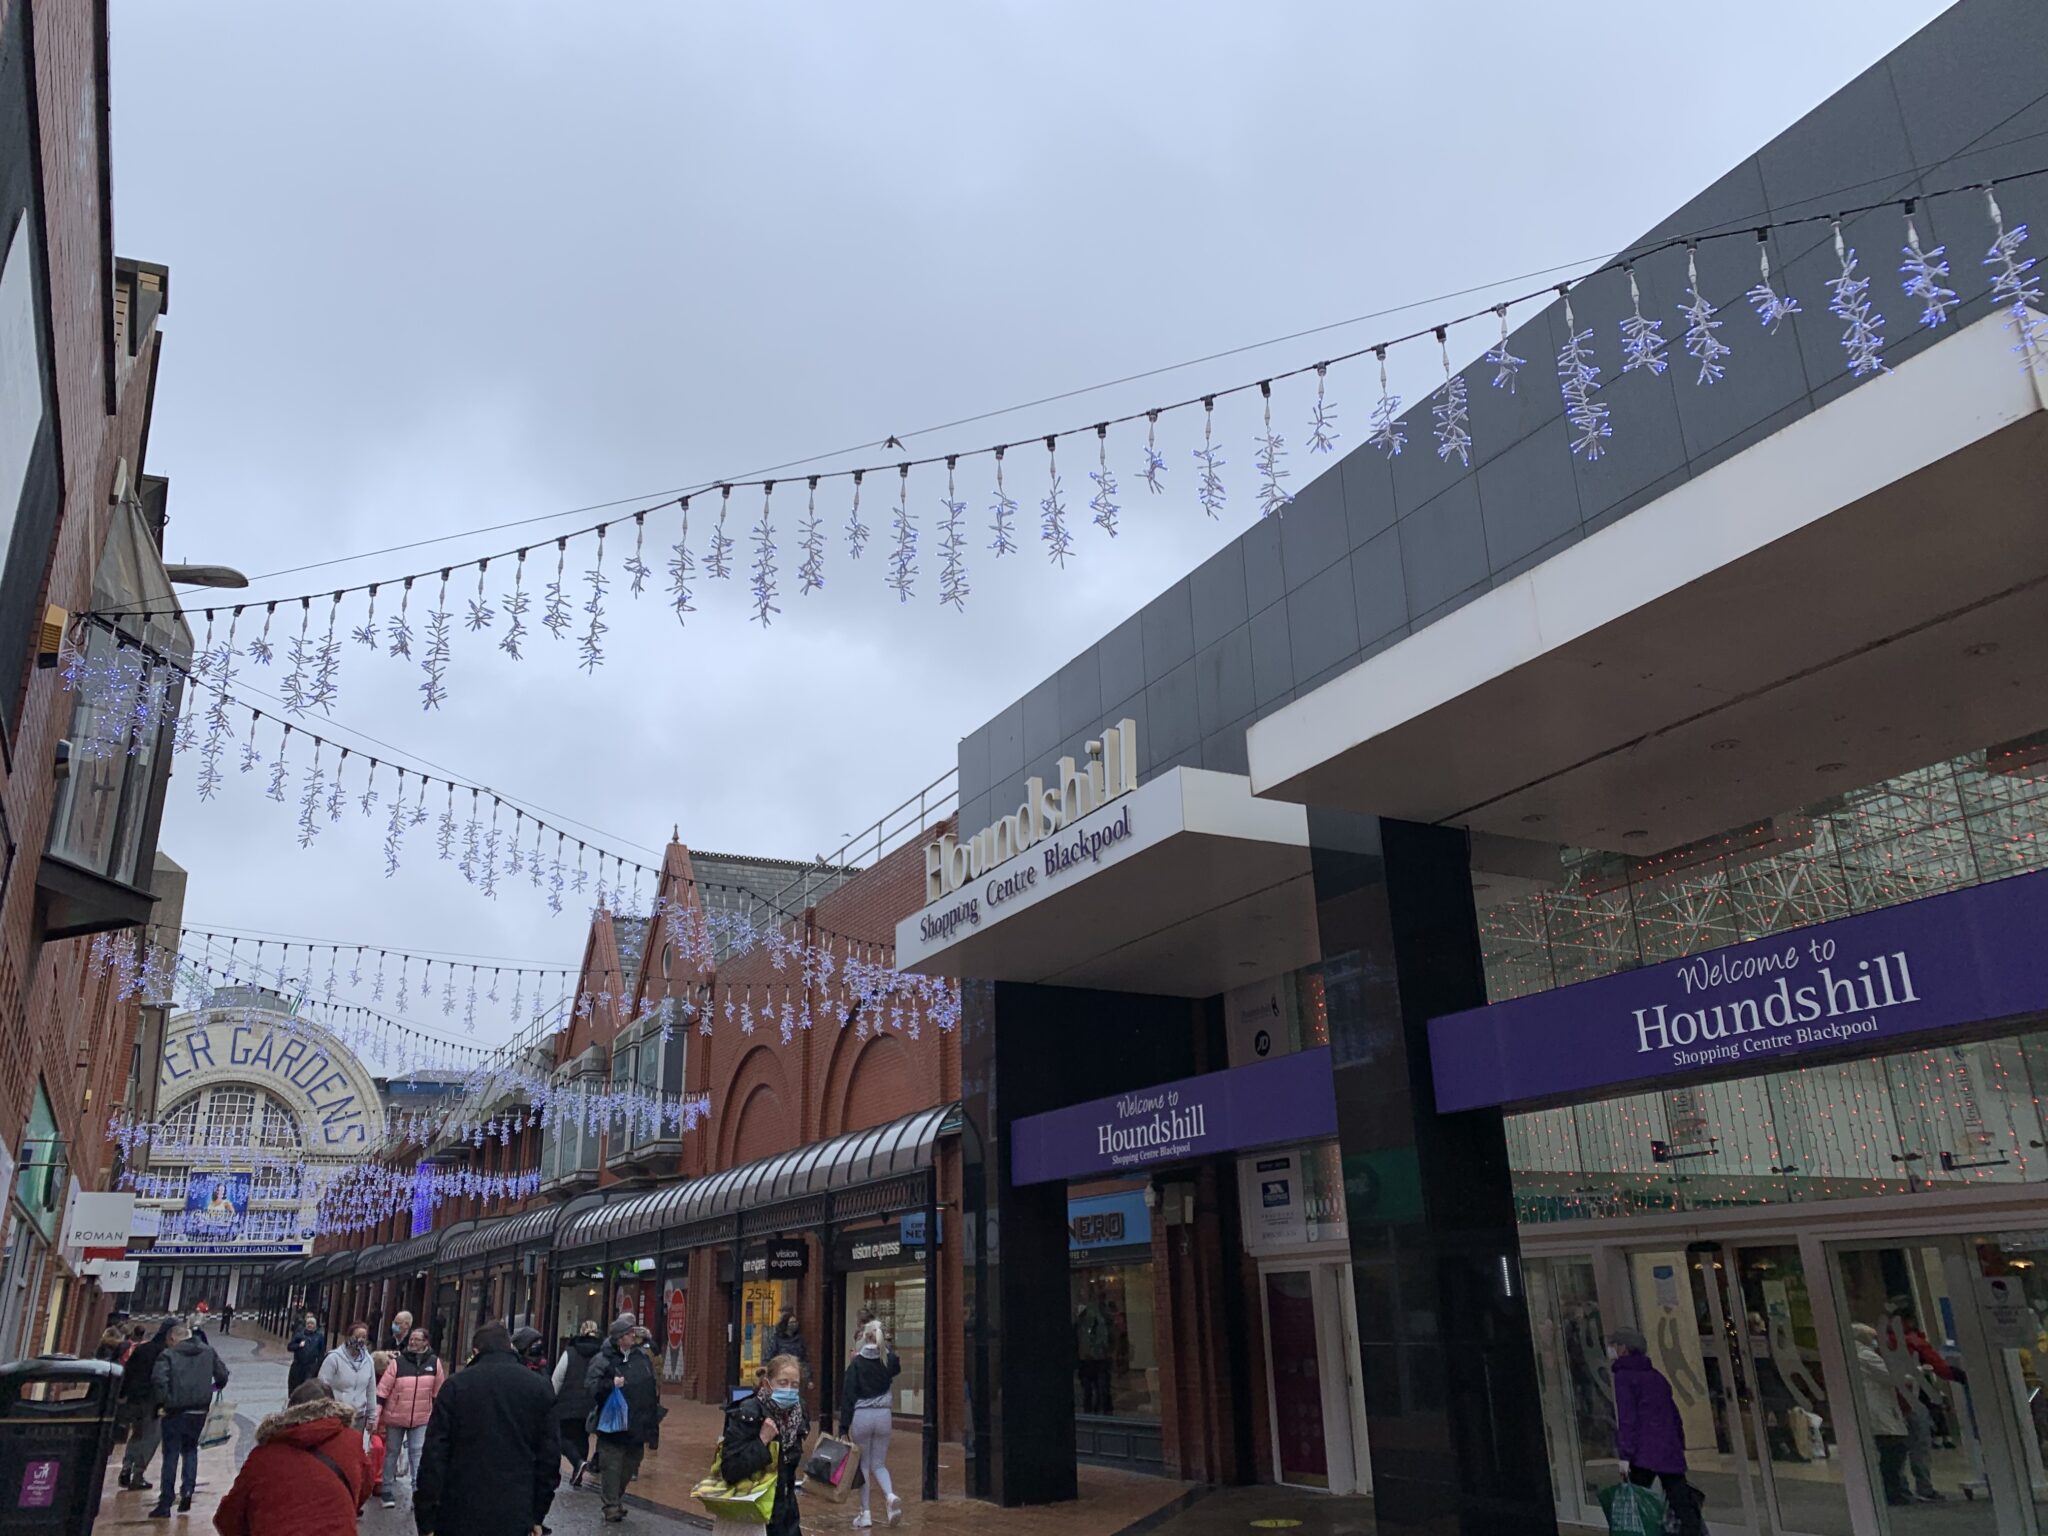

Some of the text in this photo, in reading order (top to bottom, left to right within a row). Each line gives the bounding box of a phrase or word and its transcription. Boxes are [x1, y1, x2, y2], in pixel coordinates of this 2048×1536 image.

[922, 717, 1138, 904] Houndshill
[920, 805, 1131, 942] Shopping Centre Blackpool
[1677, 937, 1837, 995] Welcome to
[1632, 951, 1921, 1054] Houndshill
[161, 1031, 215, 1085] ER
[1672, 1015, 1879, 1067] Shopping Centre Blackpool
[231, 1027, 366, 1144] GARDENS
[1117, 1090, 1179, 1119] Welcome to
[1097, 1104, 1206, 1155] Houndshill
[1111, 1142, 1191, 1167] Shopping Centre Blackpool
[75, 1231, 124, 1240] ROMAN
[213, 1245, 246, 1253] WINTER
[249, 1245, 289, 1253] GARDENS
[775, 1248, 798, 1258] vision
[852, 1243, 872, 1260] vision
[872, 1242, 900, 1261] express
[771, 1259, 802, 1269] express
[669, 1318, 683, 1333] SALE
